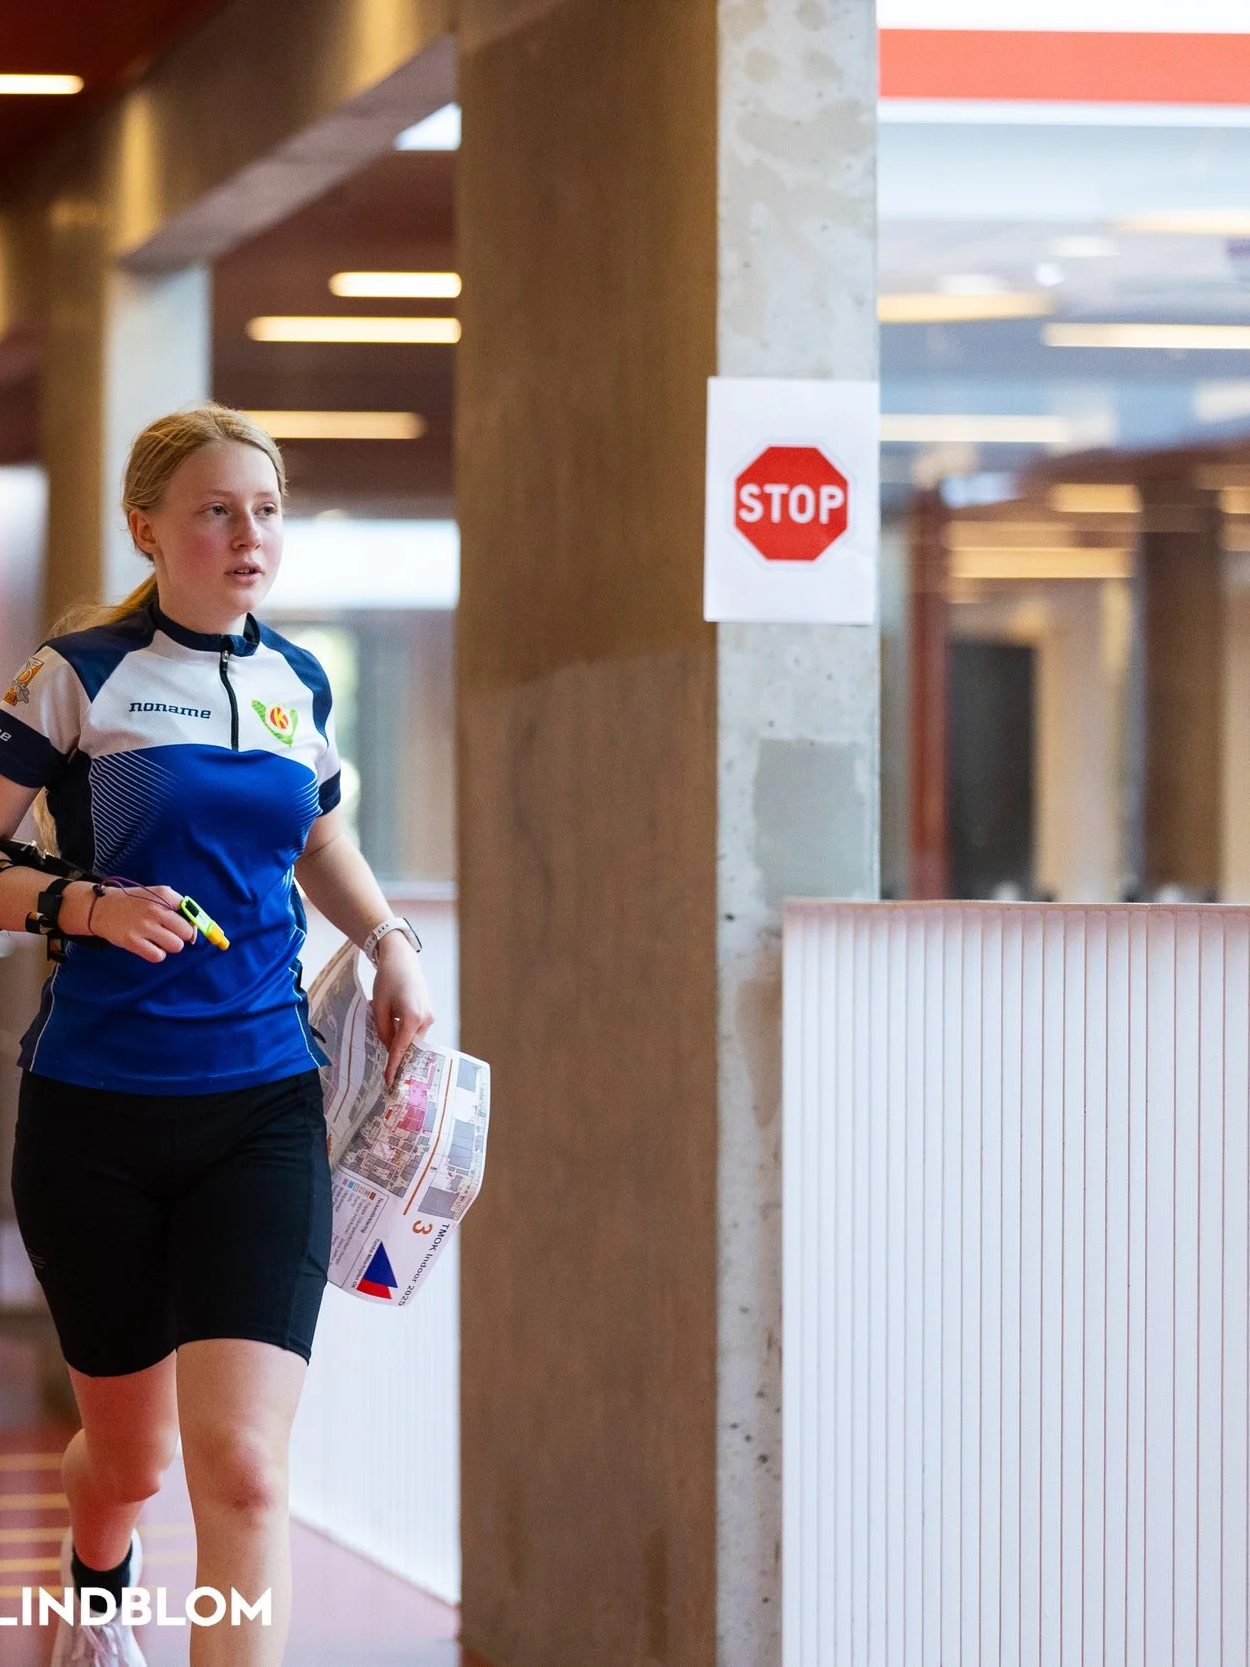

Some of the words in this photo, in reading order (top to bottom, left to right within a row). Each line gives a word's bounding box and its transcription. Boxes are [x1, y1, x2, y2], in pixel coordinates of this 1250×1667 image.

[738, 483, 845, 524] STOP
[129, 702, 212, 719] noname
[412, 1220, 433, 1235] 3
[429, 1224, 450, 1251] TMOK
[412, 1253, 433, 1283] Indoor
[398, 1285, 415, 1306] 2025
